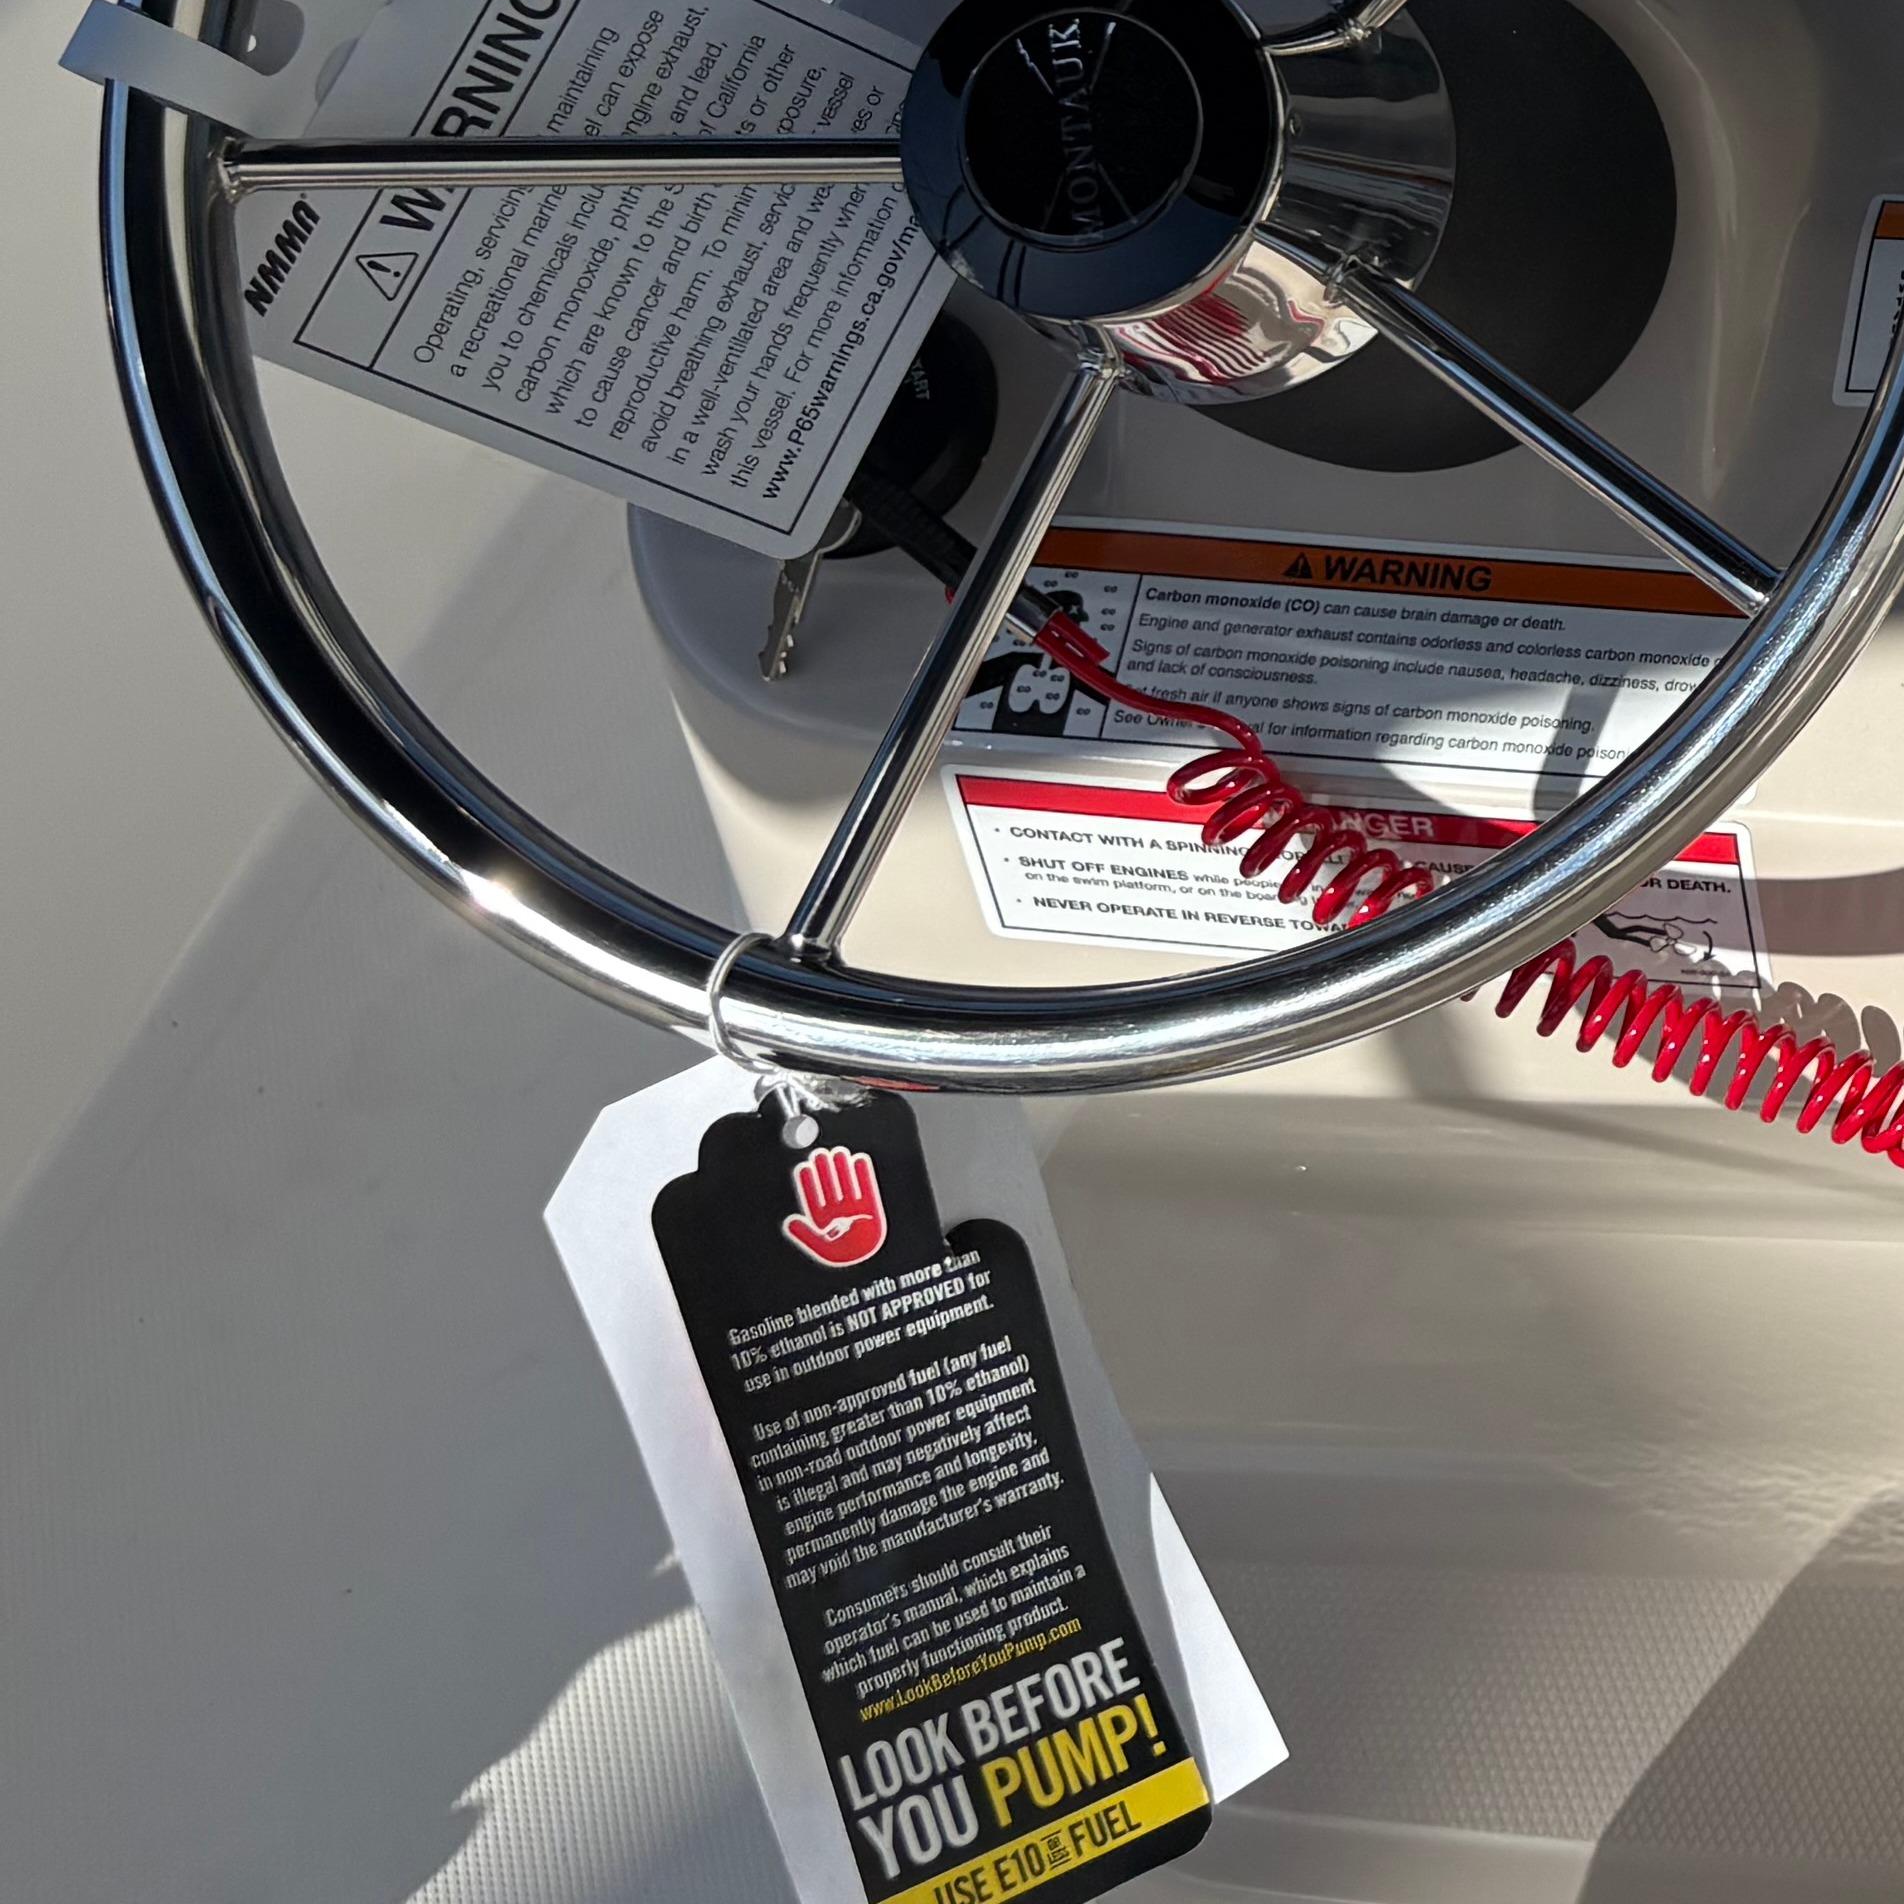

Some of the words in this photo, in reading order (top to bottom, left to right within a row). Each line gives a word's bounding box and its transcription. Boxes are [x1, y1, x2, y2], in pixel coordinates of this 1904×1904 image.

[546, 26, 620, 138] maintaining
[669, 84, 700, 124] and
[687, 41, 729, 84] lead,
[705, 35, 767, 119] California
[243, 197, 322, 318] NMMA
[413, 267, 486, 364] Operating,
[514, 335, 562, 403] carbon
[552, 236, 620, 332] monoxide,
[545, 358, 587, 414] which
[578, 323, 606, 356] are
[592, 257, 644, 321] known
[631, 233, 655, 253] to
[645, 198, 675, 230] the
[729, 454, 760, 488] this
[751, 390, 796, 449] vessel.
[782, 349, 814, 384] For
[807, 300, 842, 349] more
[831, 196, 899, 298] information
[1145, 587, 1202, 604] Carbon
[1204, 594, 1282, 610] monoxide
[1284, 598, 1321, 616] (CO)
[1322, 603, 1351, 615] can
[1353, 605, 1398, 620] cause
[1400, 607, 1437, 622] brain
[1440, 610, 1500, 629] damage
[1502, 616, 1520, 627] or
[1521, 615, 1566, 631] death.
[1324, 554, 1492, 593] WARNING
[1009, 826, 1094, 844] CONTACT
[1097, 834, 1145, 849] WITH
[1149, 838, 1163, 850] A
[1018, 856, 1066, 870] SHUT
[1071, 861, 1105, 874] OFF
[1109, 864, 1189, 881] ENGINES
[1033, 896, 1093, 912] NEVER
[1096, 902, 1178, 920] OPERATE
[1181, 909, 1200, 921] IN
[1203, 911, 1286, 929] REVERSE
[1666, 878, 1731, 894] DEATH.
[728, 1313, 795, 1346] Gasoline
[796, 1287, 860, 1324] blended
[861, 1276, 897, 1302] with
[899, 1263, 943, 1289] more
[731, 1345, 768, 1370] 10%
[770, 1324, 828, 1358] ethanol
[828, 1320, 845, 1338] is
[846, 1306, 877, 1332] NOT
[881, 1277, 965, 1321] APPROVED
[967, 1270, 991, 1290] for
[860, 1618, 1082, 1722] www.LookBeforeYouPump.com
[839, 1712, 966, 1810] LOOK
[961, 1637, 1140, 1759] BEFORE
[857, 1776, 979, 1880] YOU
[981, 1693, 1167, 1826] PUMP!
[1067, 1800, 1142, 1857] FUEL
[993, 1843, 1046, 1891] E10
